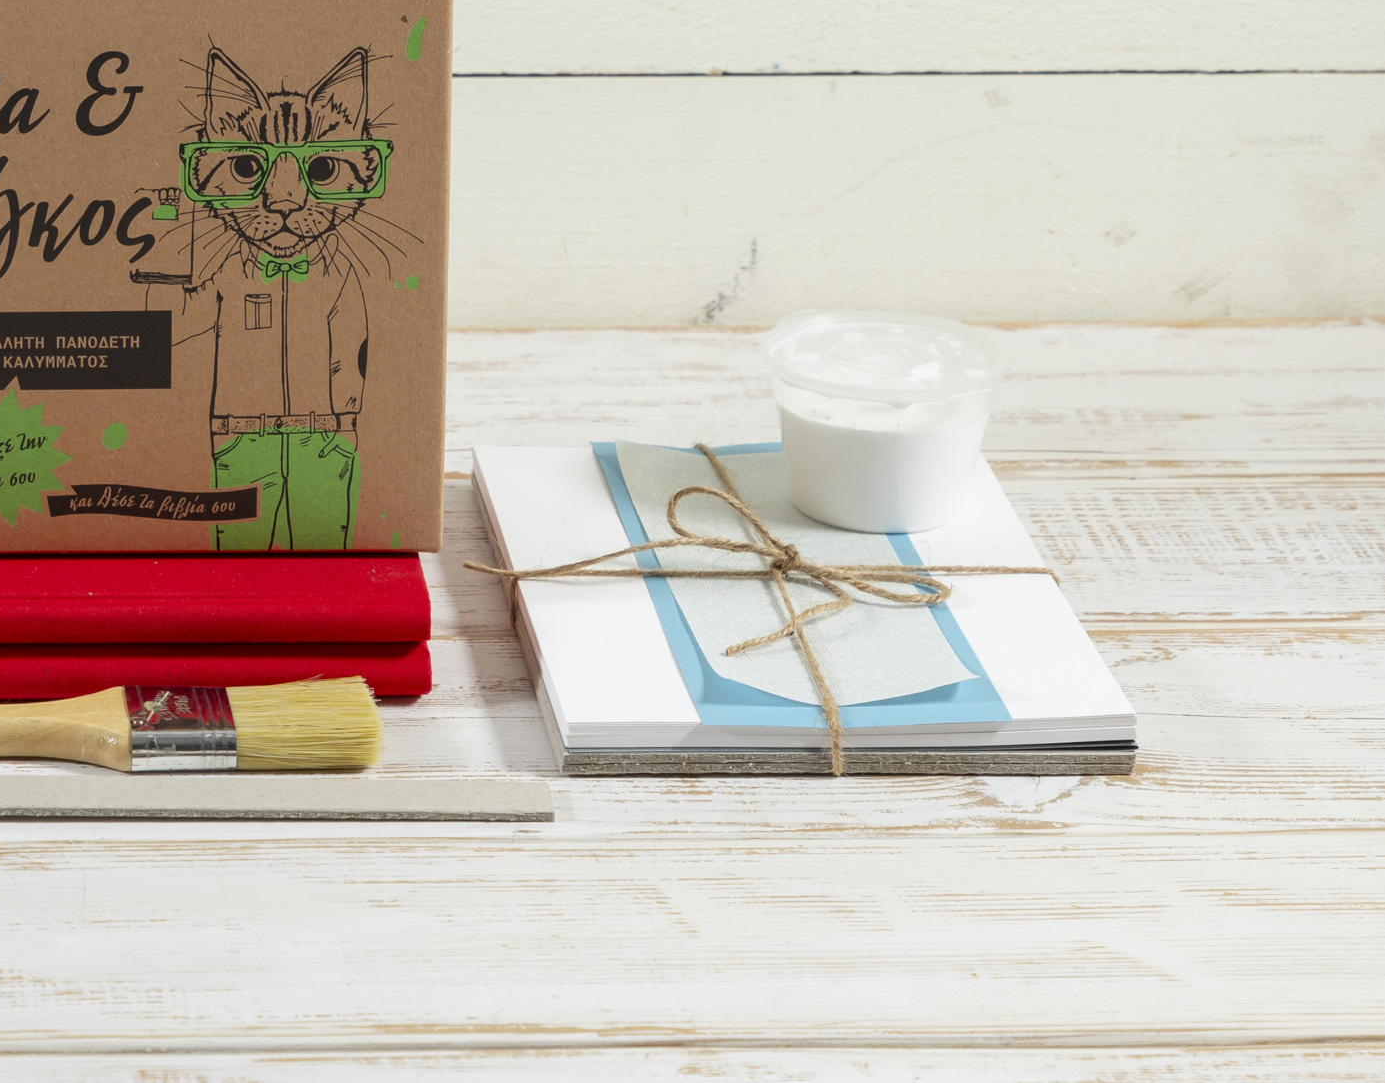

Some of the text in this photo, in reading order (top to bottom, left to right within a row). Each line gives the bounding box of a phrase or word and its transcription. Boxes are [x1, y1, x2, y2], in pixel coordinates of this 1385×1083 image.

[75, 50, 144, 137] &
[56, 335, 141, 350] ΠΑΝΟΔΕΤΗ
[3, 354, 109, 369] ΚΑΛΥΜΜΑΤΟΣ
